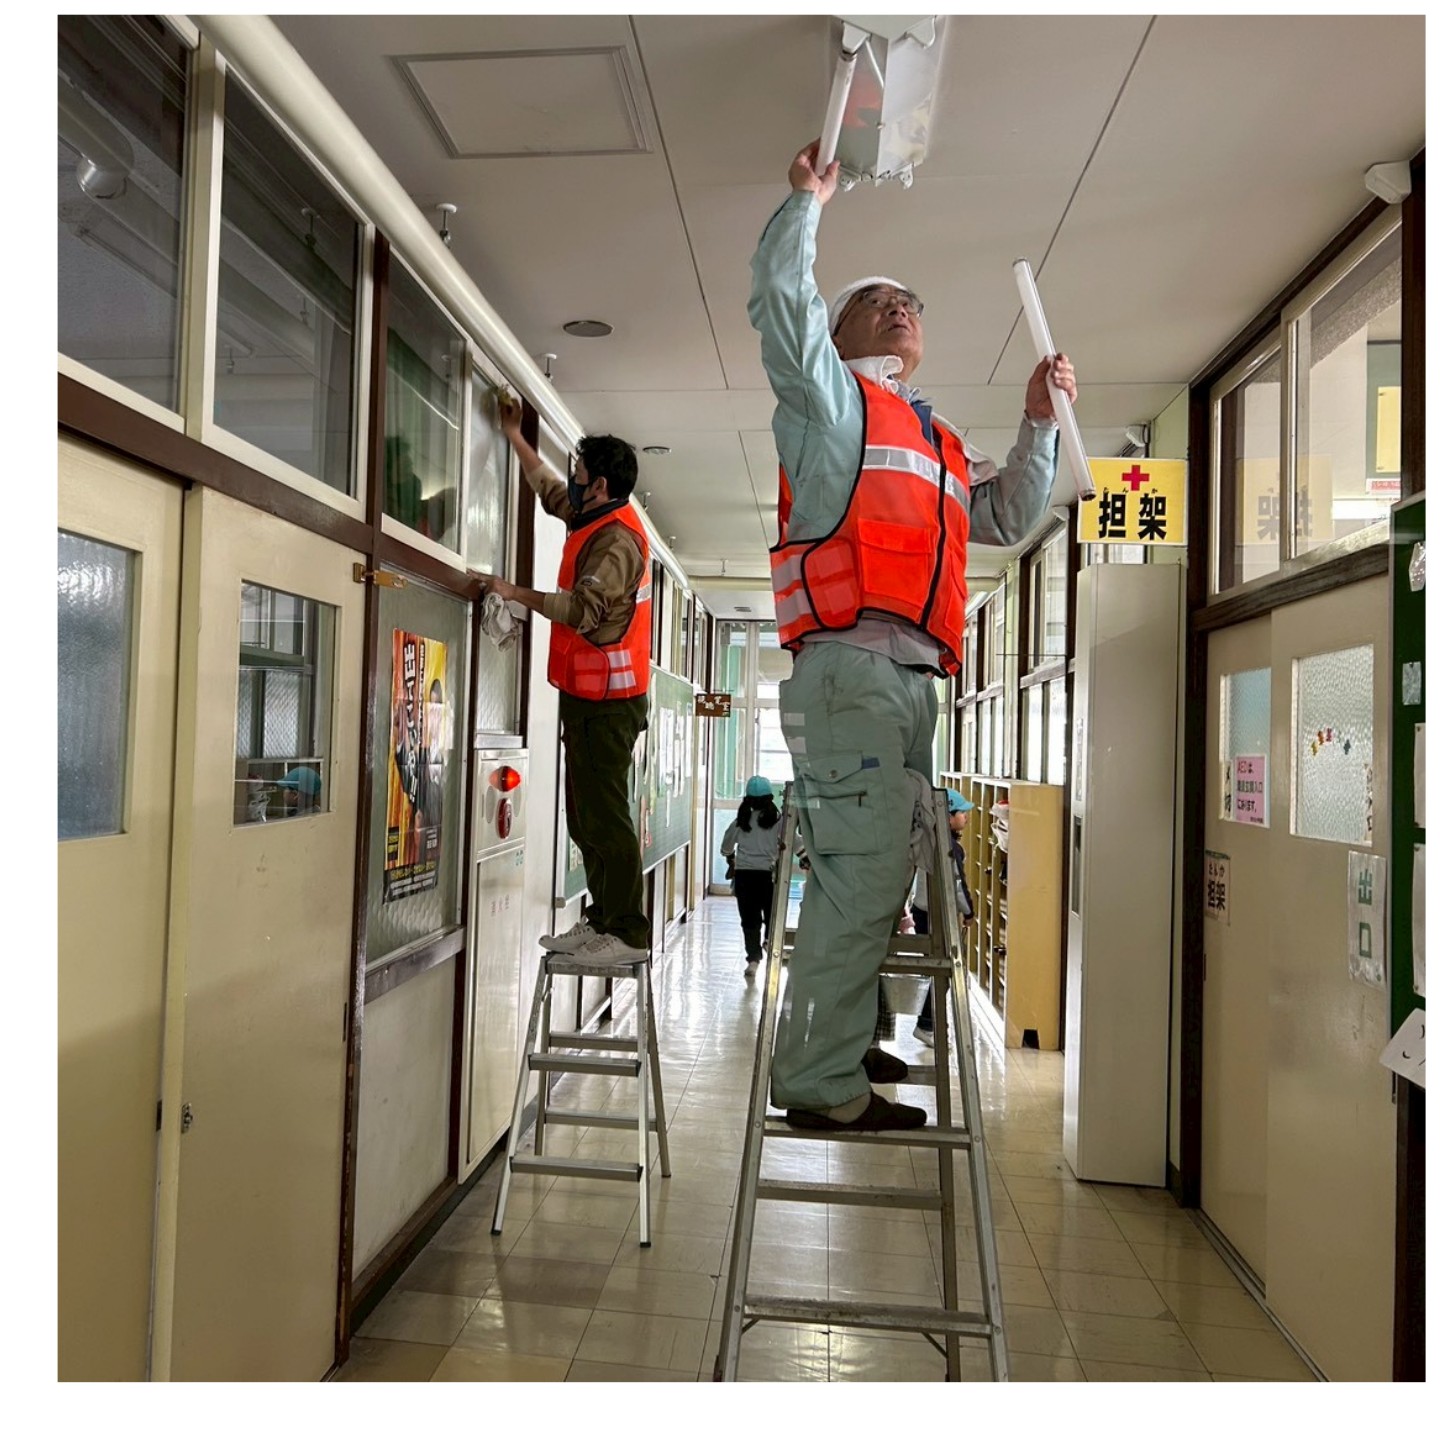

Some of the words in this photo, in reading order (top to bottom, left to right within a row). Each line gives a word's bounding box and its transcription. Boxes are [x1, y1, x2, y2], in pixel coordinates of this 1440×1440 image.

[1098, 492, 1167, 540] 担架
[1208, 879, 1226, 911] 担架
[1358, 868, 1372, 959] 出口
